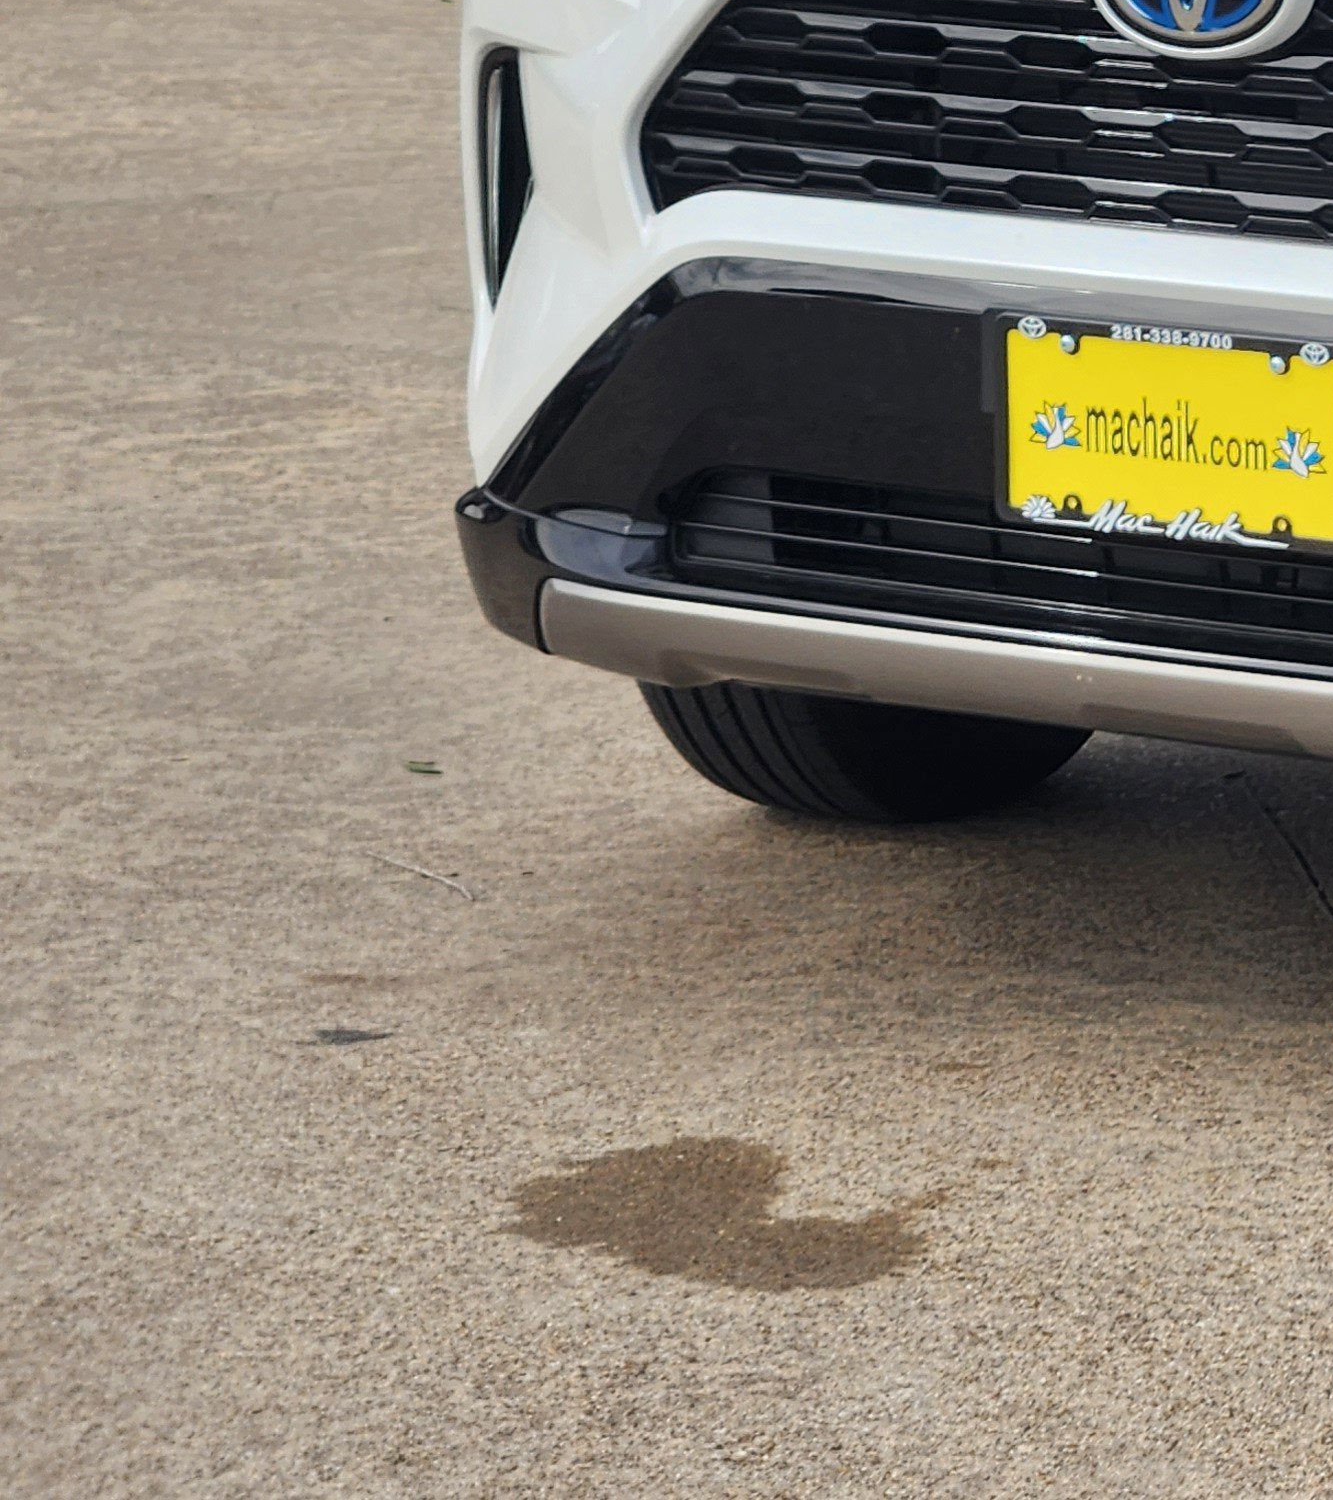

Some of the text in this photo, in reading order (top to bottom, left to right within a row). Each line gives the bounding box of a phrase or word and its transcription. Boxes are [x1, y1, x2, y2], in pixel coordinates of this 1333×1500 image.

[1110, 323, 1233, 351] 281-338-9700
[1085, 396, 1268, 471] machaik.com
[1084, 499, 1264, 546] Mac Haik
